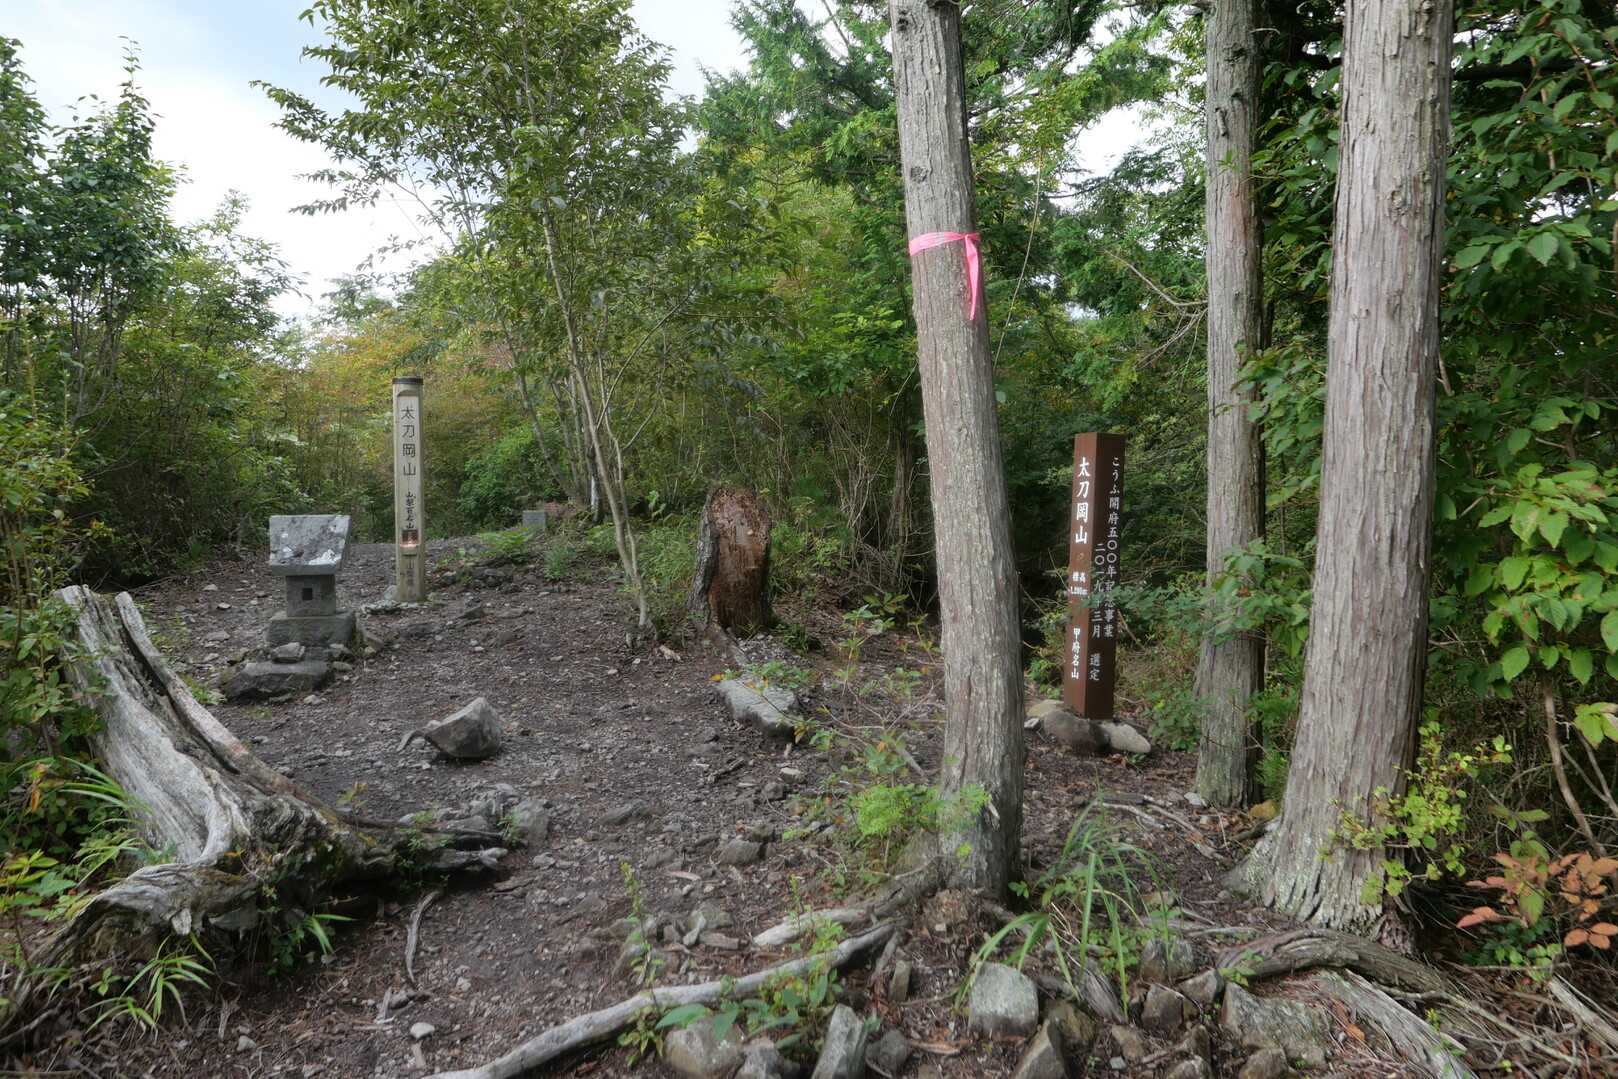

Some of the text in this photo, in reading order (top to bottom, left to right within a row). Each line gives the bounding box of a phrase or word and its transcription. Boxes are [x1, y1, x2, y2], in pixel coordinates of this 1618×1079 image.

[400, 406, 416, 476] 太刀岡山
[1075, 456, 1091, 544] 太刀岡山
[1071, 627, 1081, 680] 甲府名山
